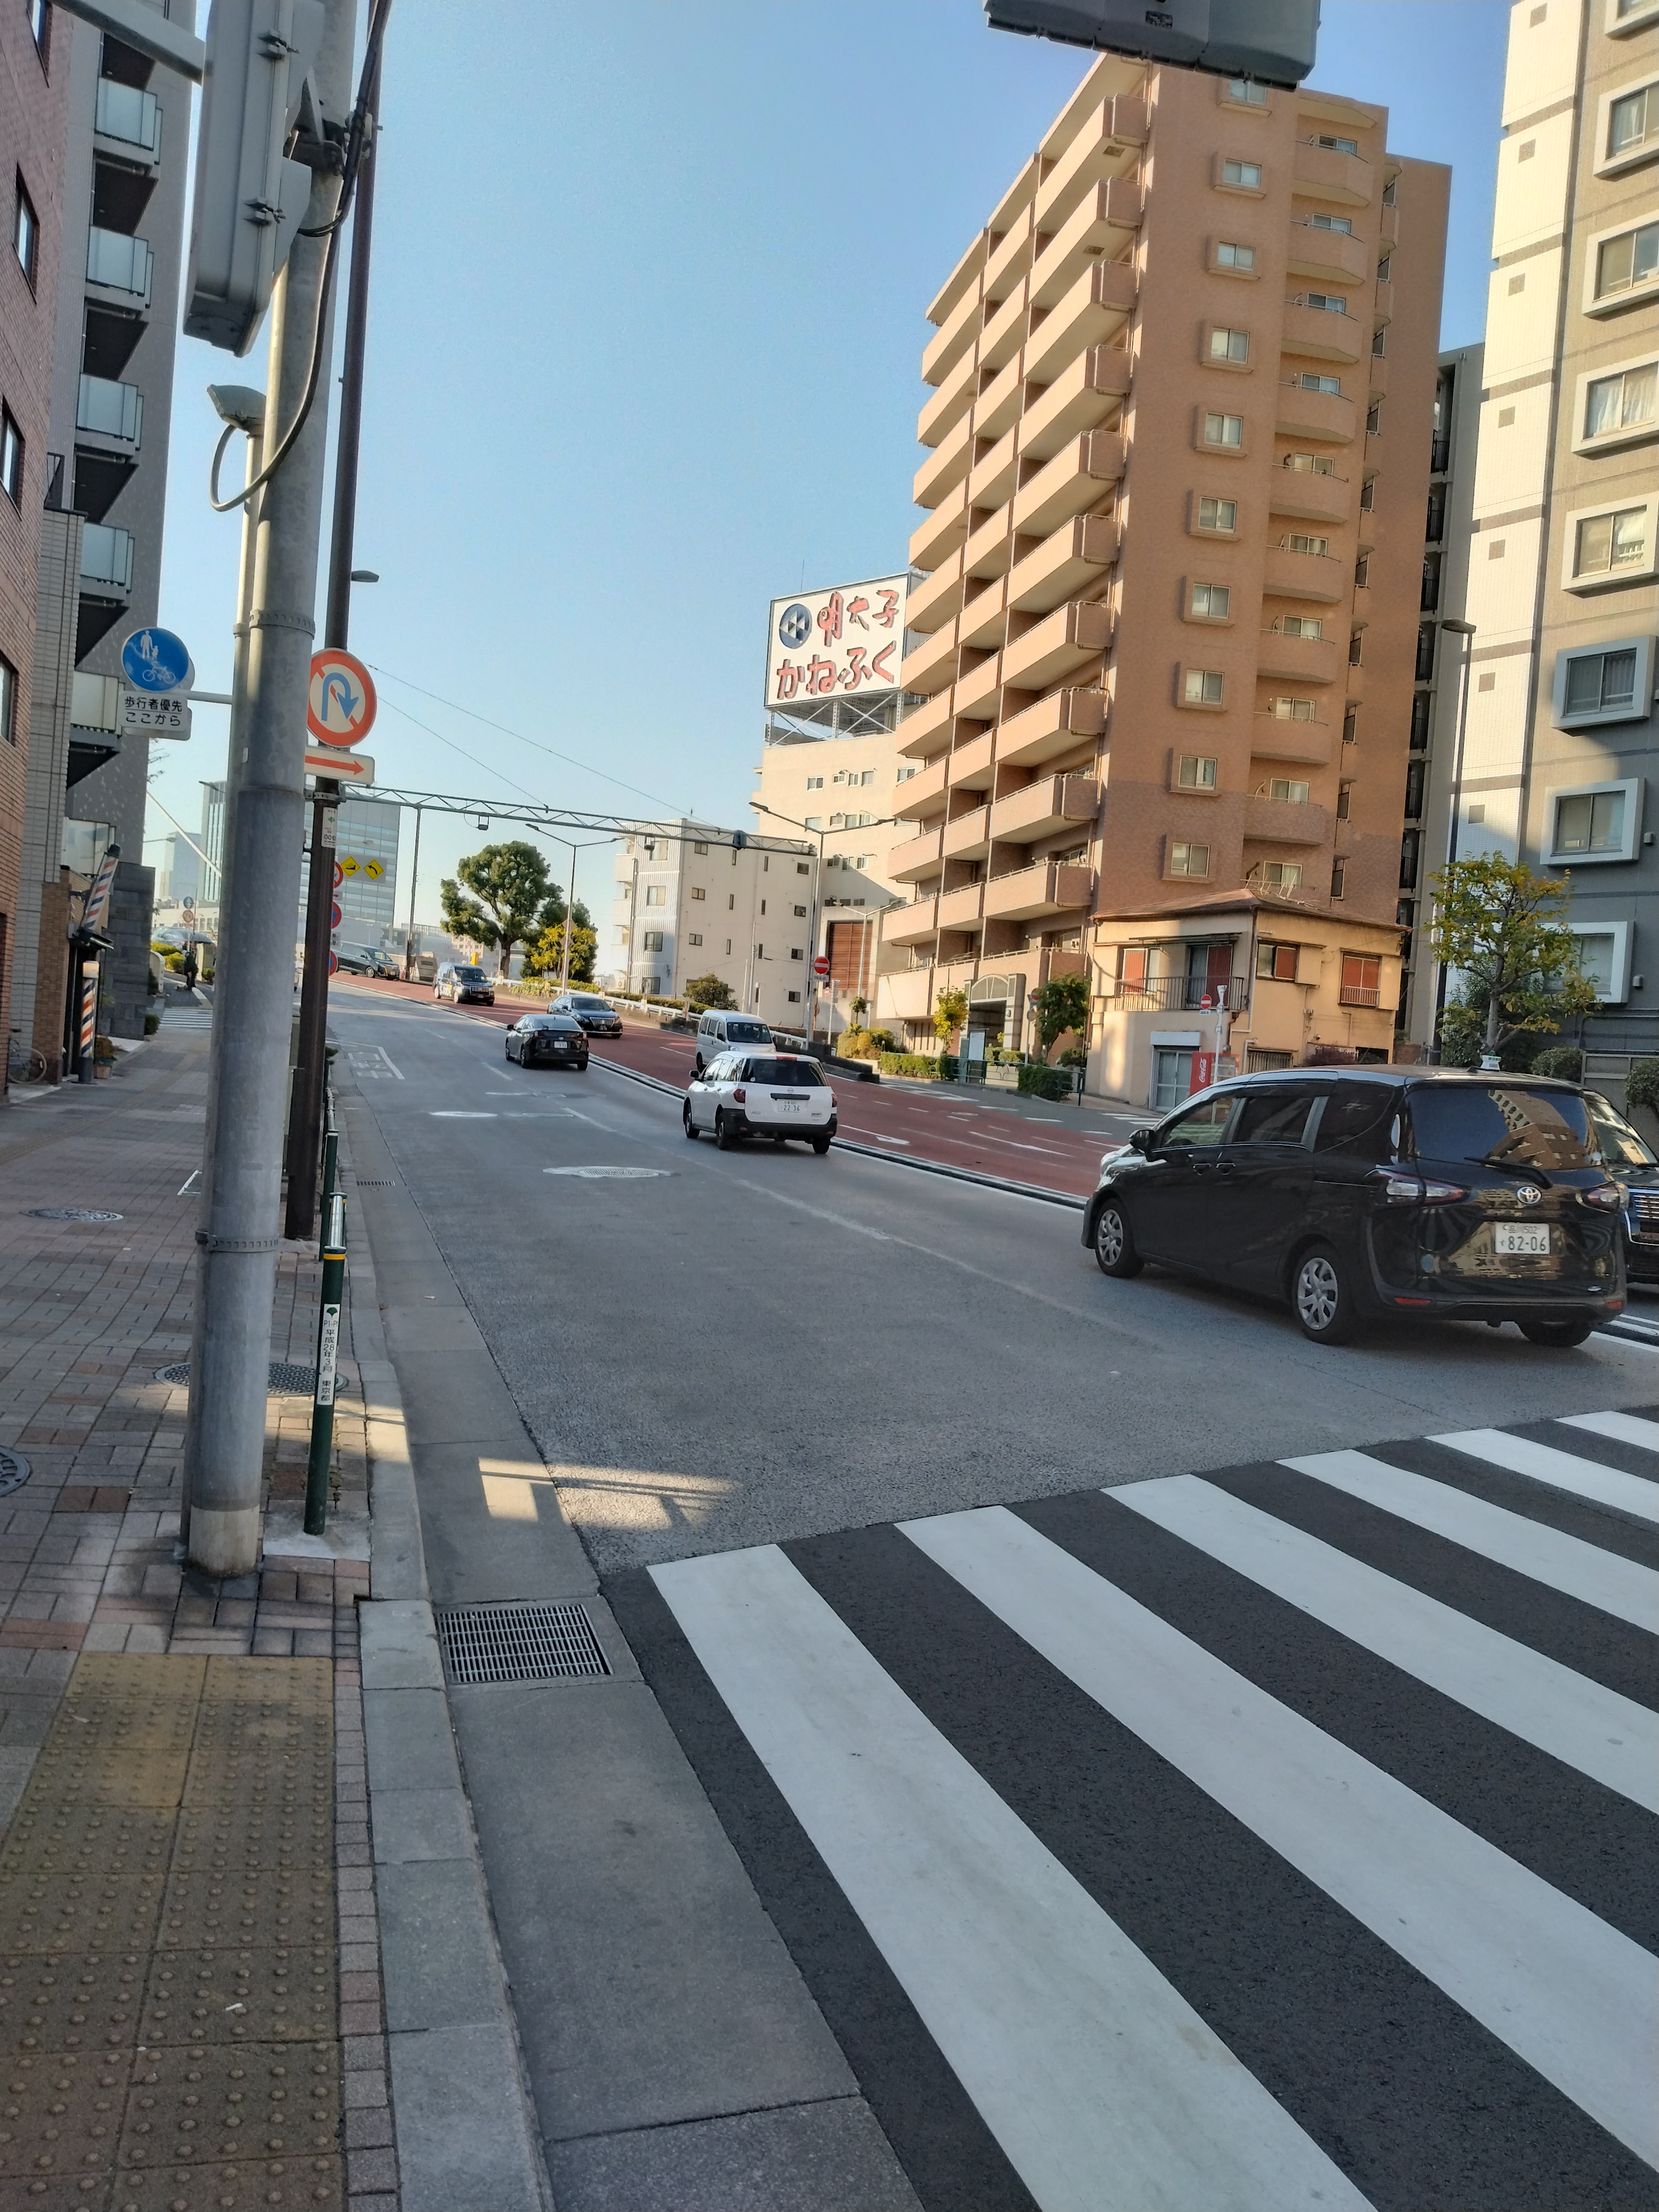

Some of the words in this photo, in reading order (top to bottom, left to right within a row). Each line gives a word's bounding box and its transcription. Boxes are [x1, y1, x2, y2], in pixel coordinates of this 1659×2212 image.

[817, 590, 900, 647] 明太子
[776, 640, 897, 700] かねふく
[124, 696, 182, 712] 歩行者優先
[125, 712, 181, 726] ここから
[1508, 1235, 1546, 1251] 82-06
[321, 1380, 331, 1401] 東京都
